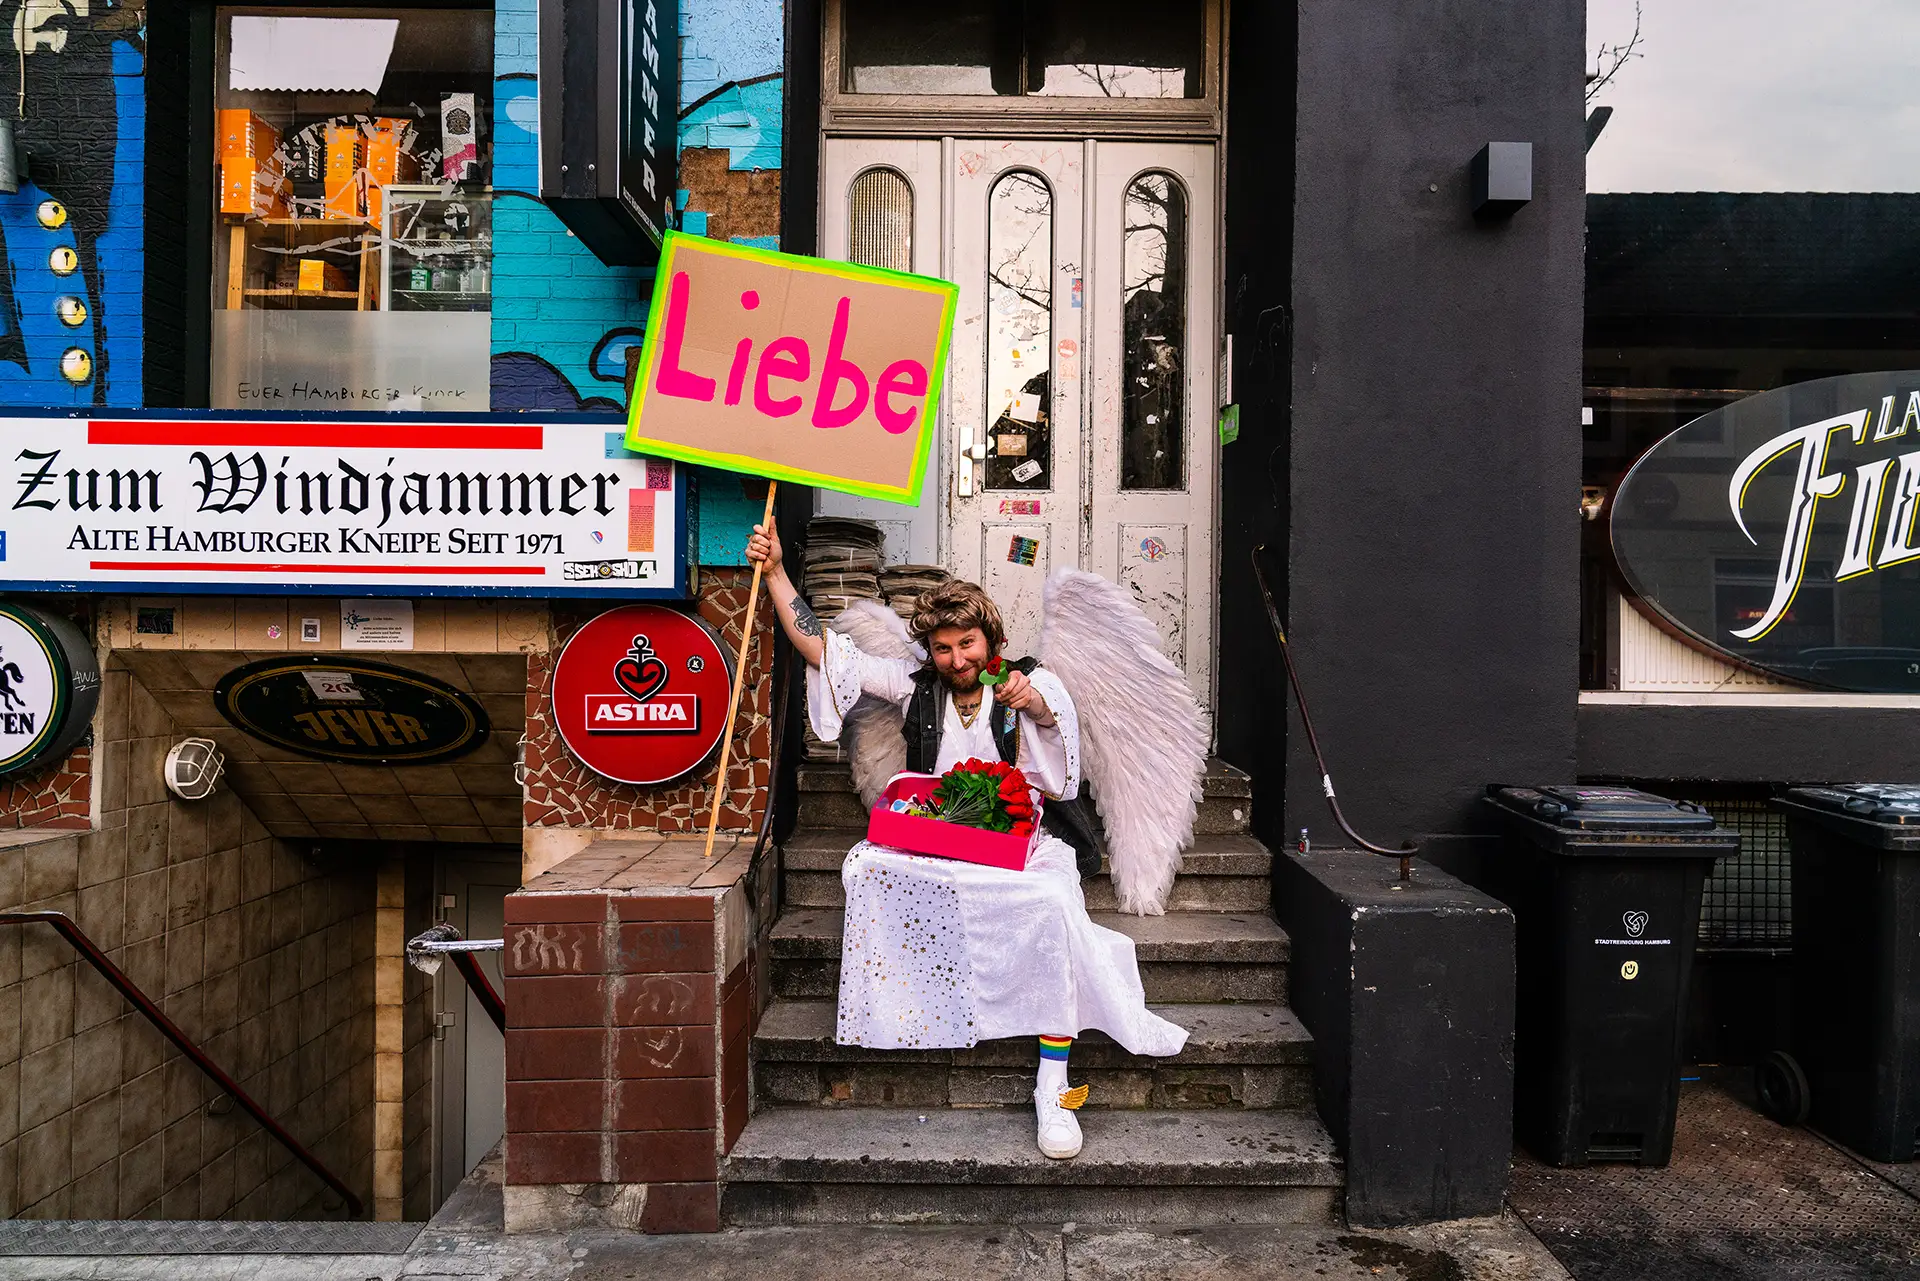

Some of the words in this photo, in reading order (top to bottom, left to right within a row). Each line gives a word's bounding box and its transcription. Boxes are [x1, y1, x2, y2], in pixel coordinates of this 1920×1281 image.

[656, 272, 928, 434] Liebe
[237, 383, 284, 399] EUER
[12, 448, 163, 512] Zum
[189, 451, 621, 527] Windjammer
[67, 524, 139, 551] ALTE
[146, 525, 331, 554] HAMBURGER
[339, 527, 440, 554] KNEIPE
[449, 527, 507, 554] SEIT
[516, 533, 565, 555] 1971
[293, 709, 429, 746] JEVER
[595, 703, 688, 722] ASTRA
[1594, 938, 1644, 946] STADTREINIGUNG
